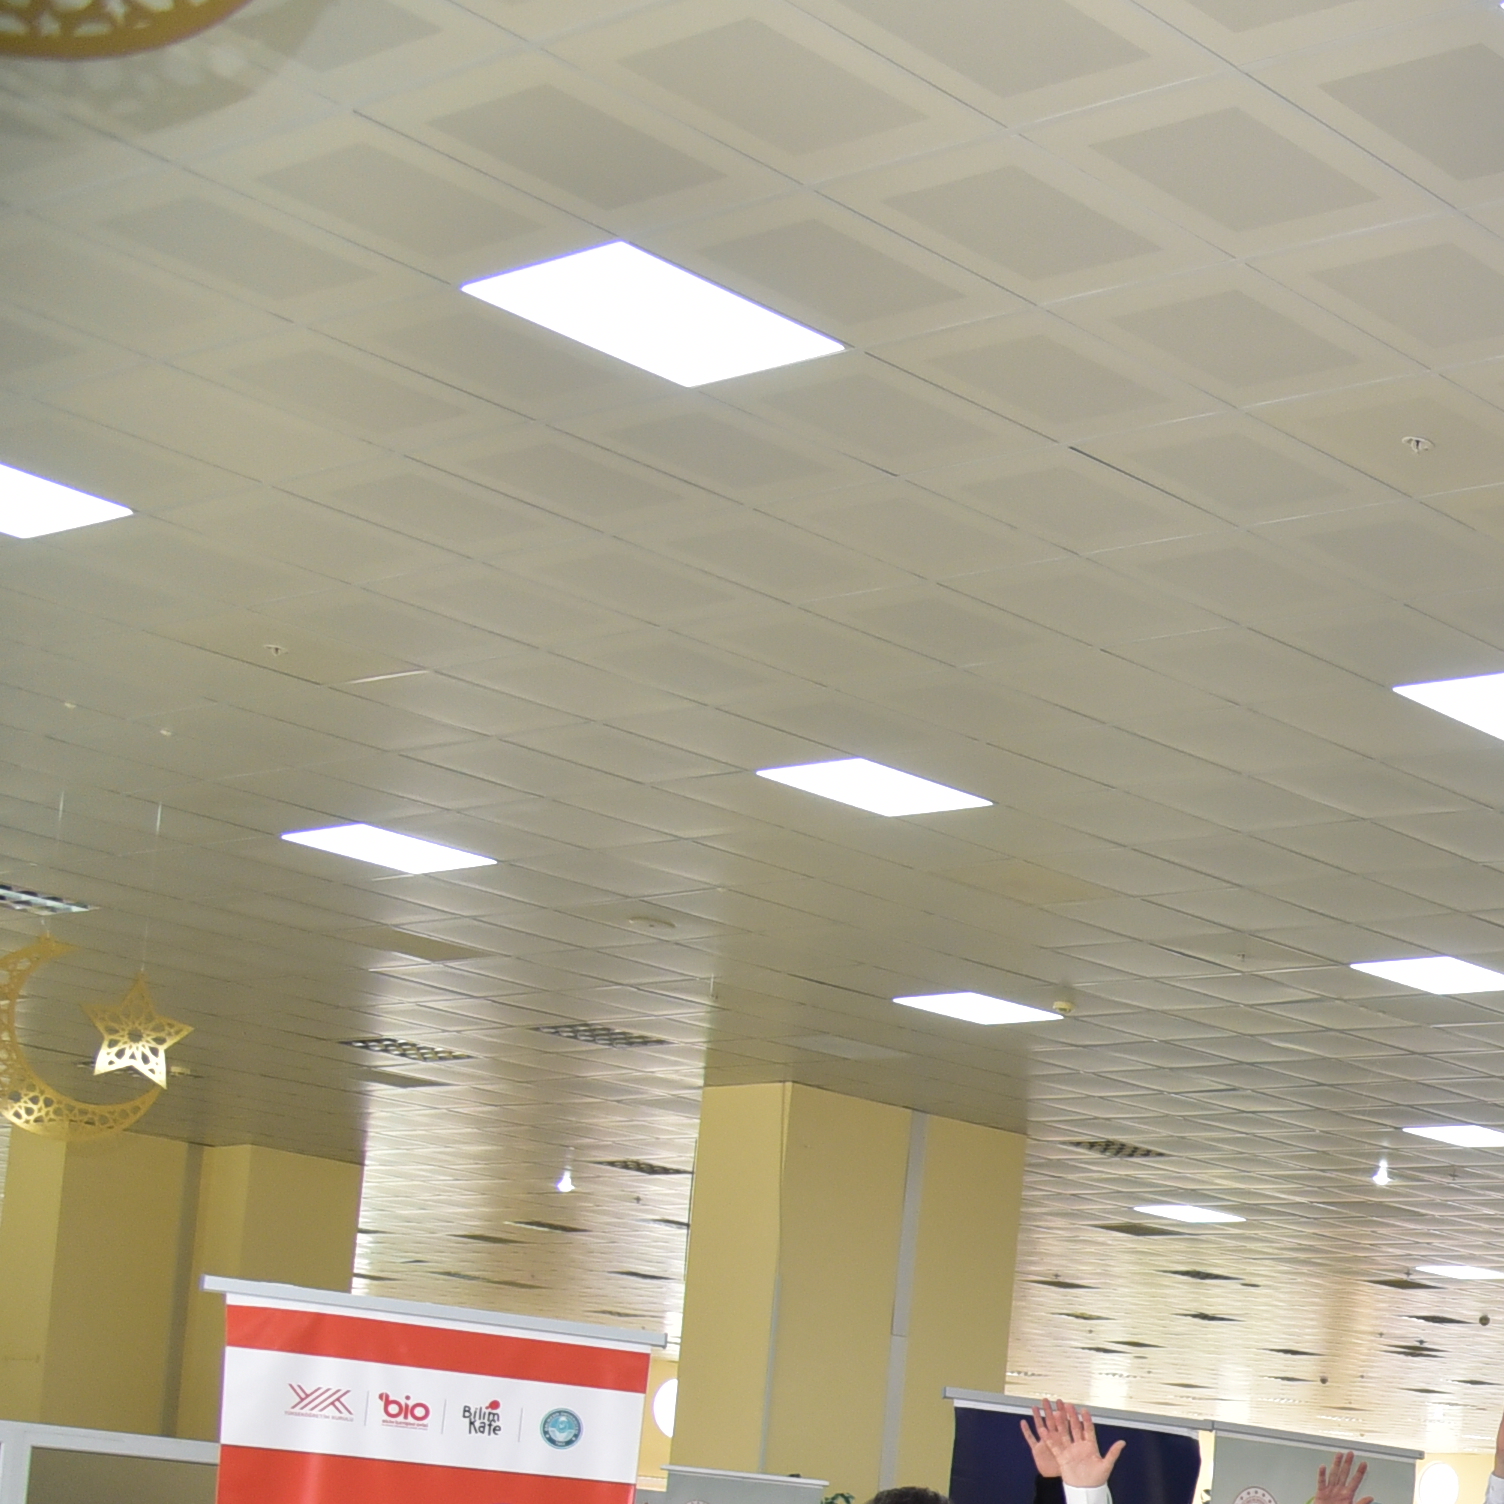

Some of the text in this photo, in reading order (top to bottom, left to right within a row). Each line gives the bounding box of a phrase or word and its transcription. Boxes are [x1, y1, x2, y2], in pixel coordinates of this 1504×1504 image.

[378, 1392, 430, 1421] bio
[462, 1405, 500, 1422] Bilim
[468, 1418, 502, 1436] Kafe
